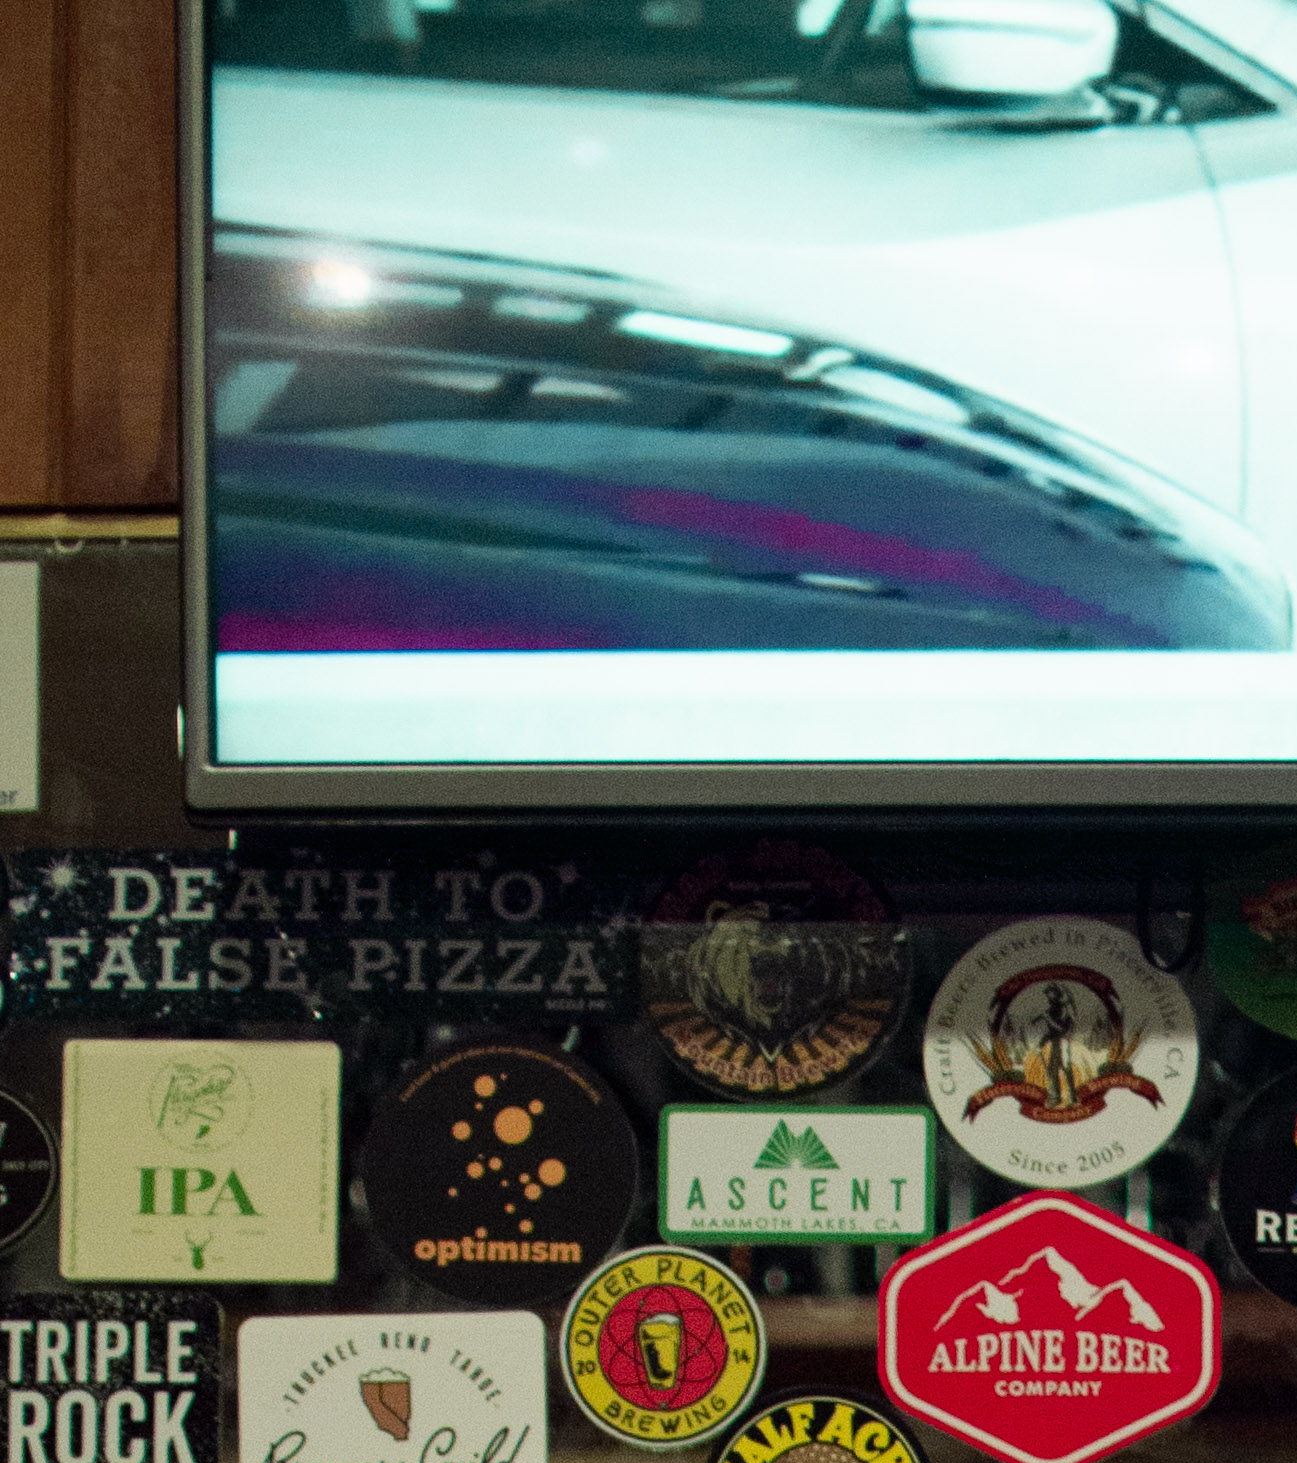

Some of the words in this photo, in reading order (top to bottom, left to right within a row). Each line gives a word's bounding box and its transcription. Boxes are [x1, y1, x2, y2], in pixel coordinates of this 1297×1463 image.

[106, 869, 394, 921] DEATH
[434, 870, 544, 920] TO
[45, 939, 306, 990] FALSE
[348, 939, 606, 991] PIZZA
[136, 1167, 262, 1216] IPA
[686, 1177, 909, 1212] ASCENT
[415, 1236, 581, 1265] optimism
[0, 1321, 196, 1382] TRIPLE
[928, 1332, 1065, 1375] ALPINE
[1076, 1330, 1170, 1373] BEER
[994, 1380, 1102, 1398] COMPANY
